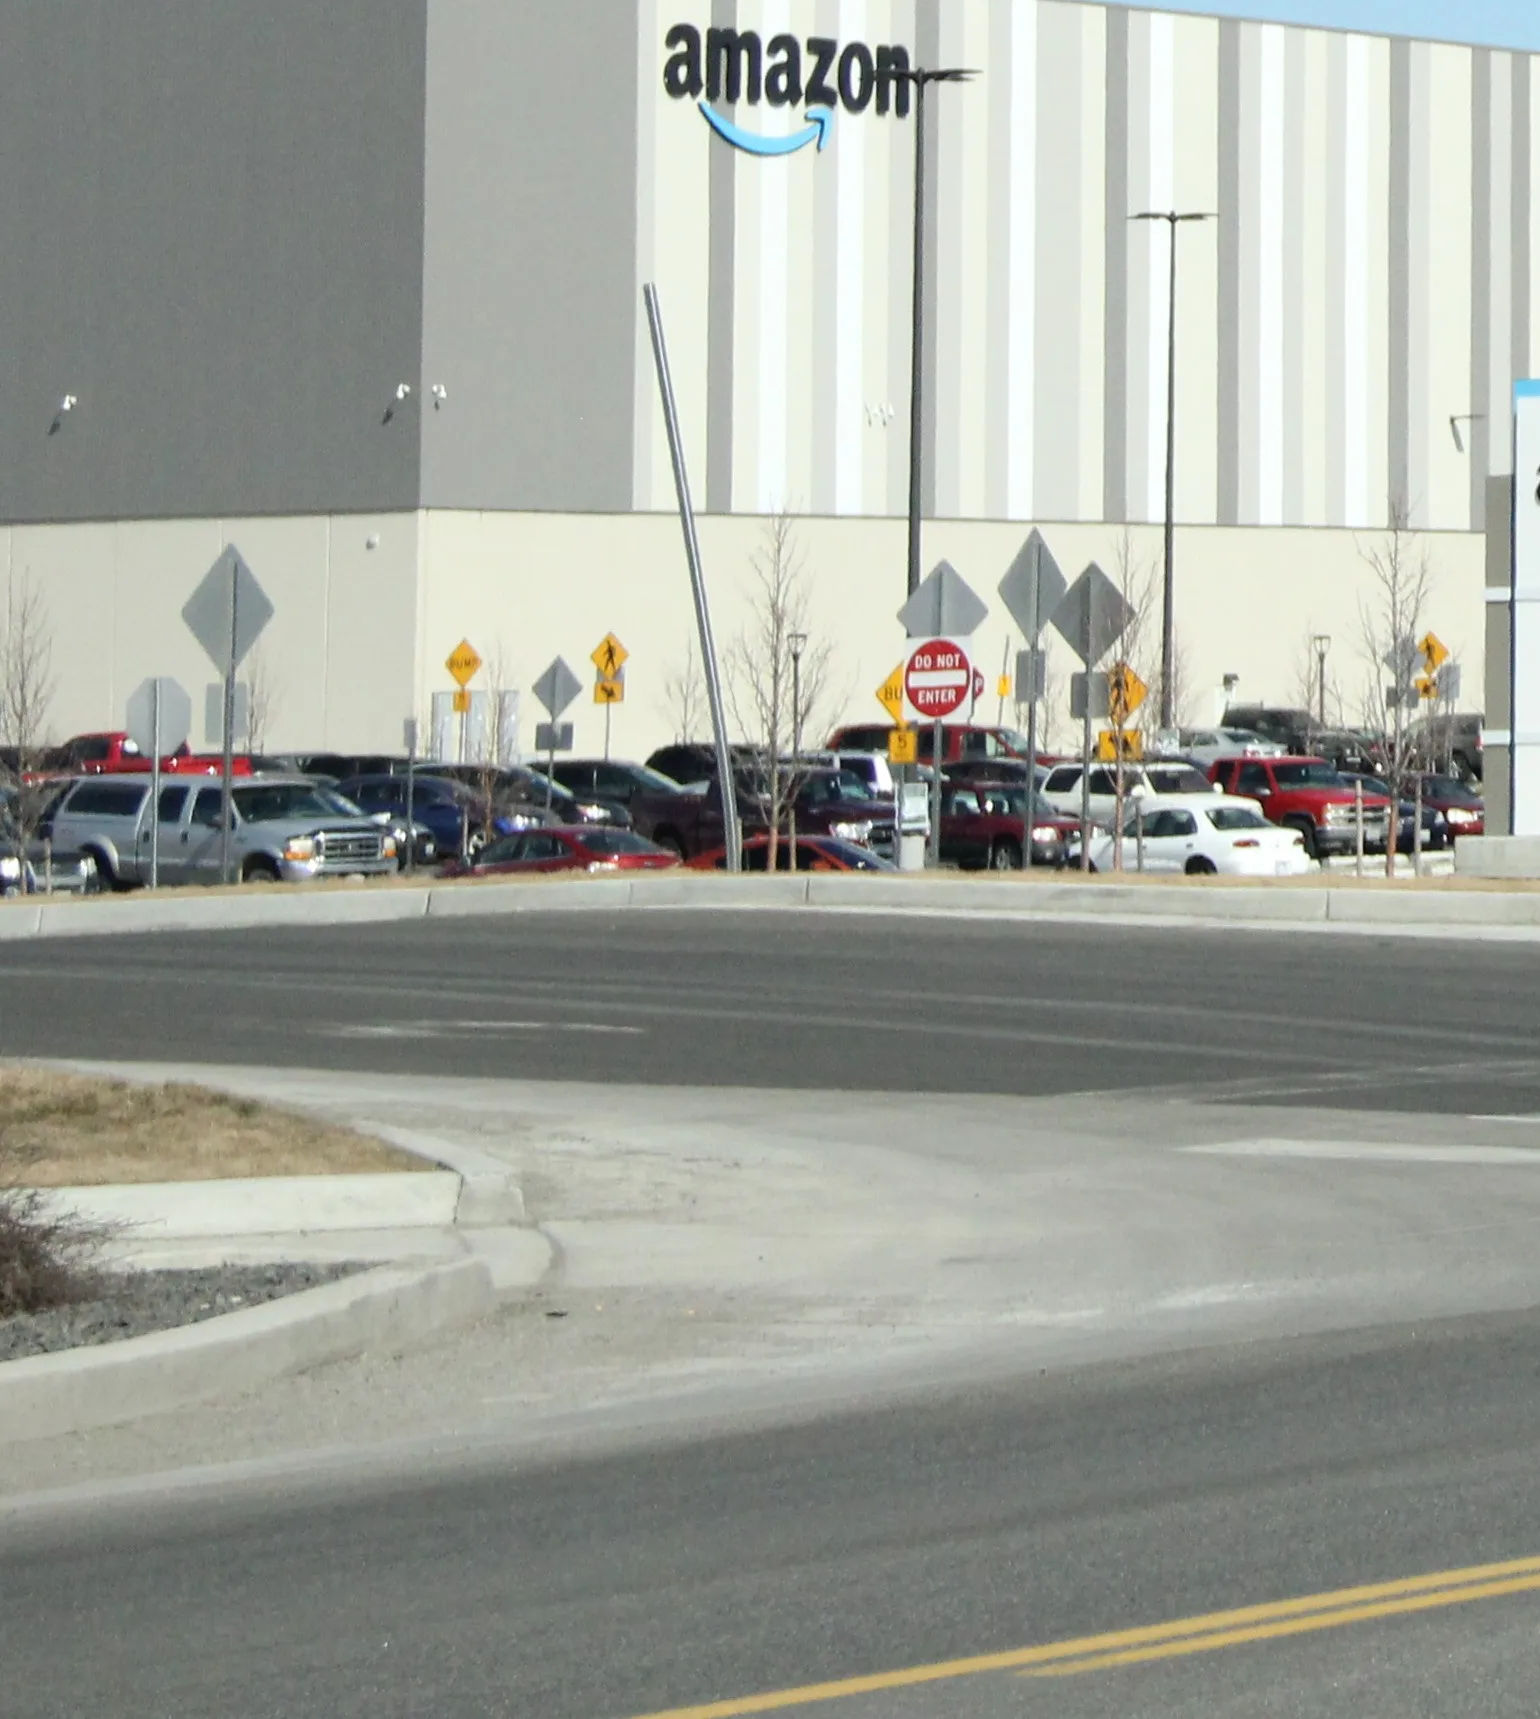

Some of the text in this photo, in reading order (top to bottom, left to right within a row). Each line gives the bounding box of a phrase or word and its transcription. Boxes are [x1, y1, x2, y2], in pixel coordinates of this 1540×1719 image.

[664, 23, 910, 119] amazon
[914, 653, 961, 669] DO NOT
[884, 686, 903, 702] BU
[917, 688, 957, 705] ENTER
[897, 734, 908, 750] 5
